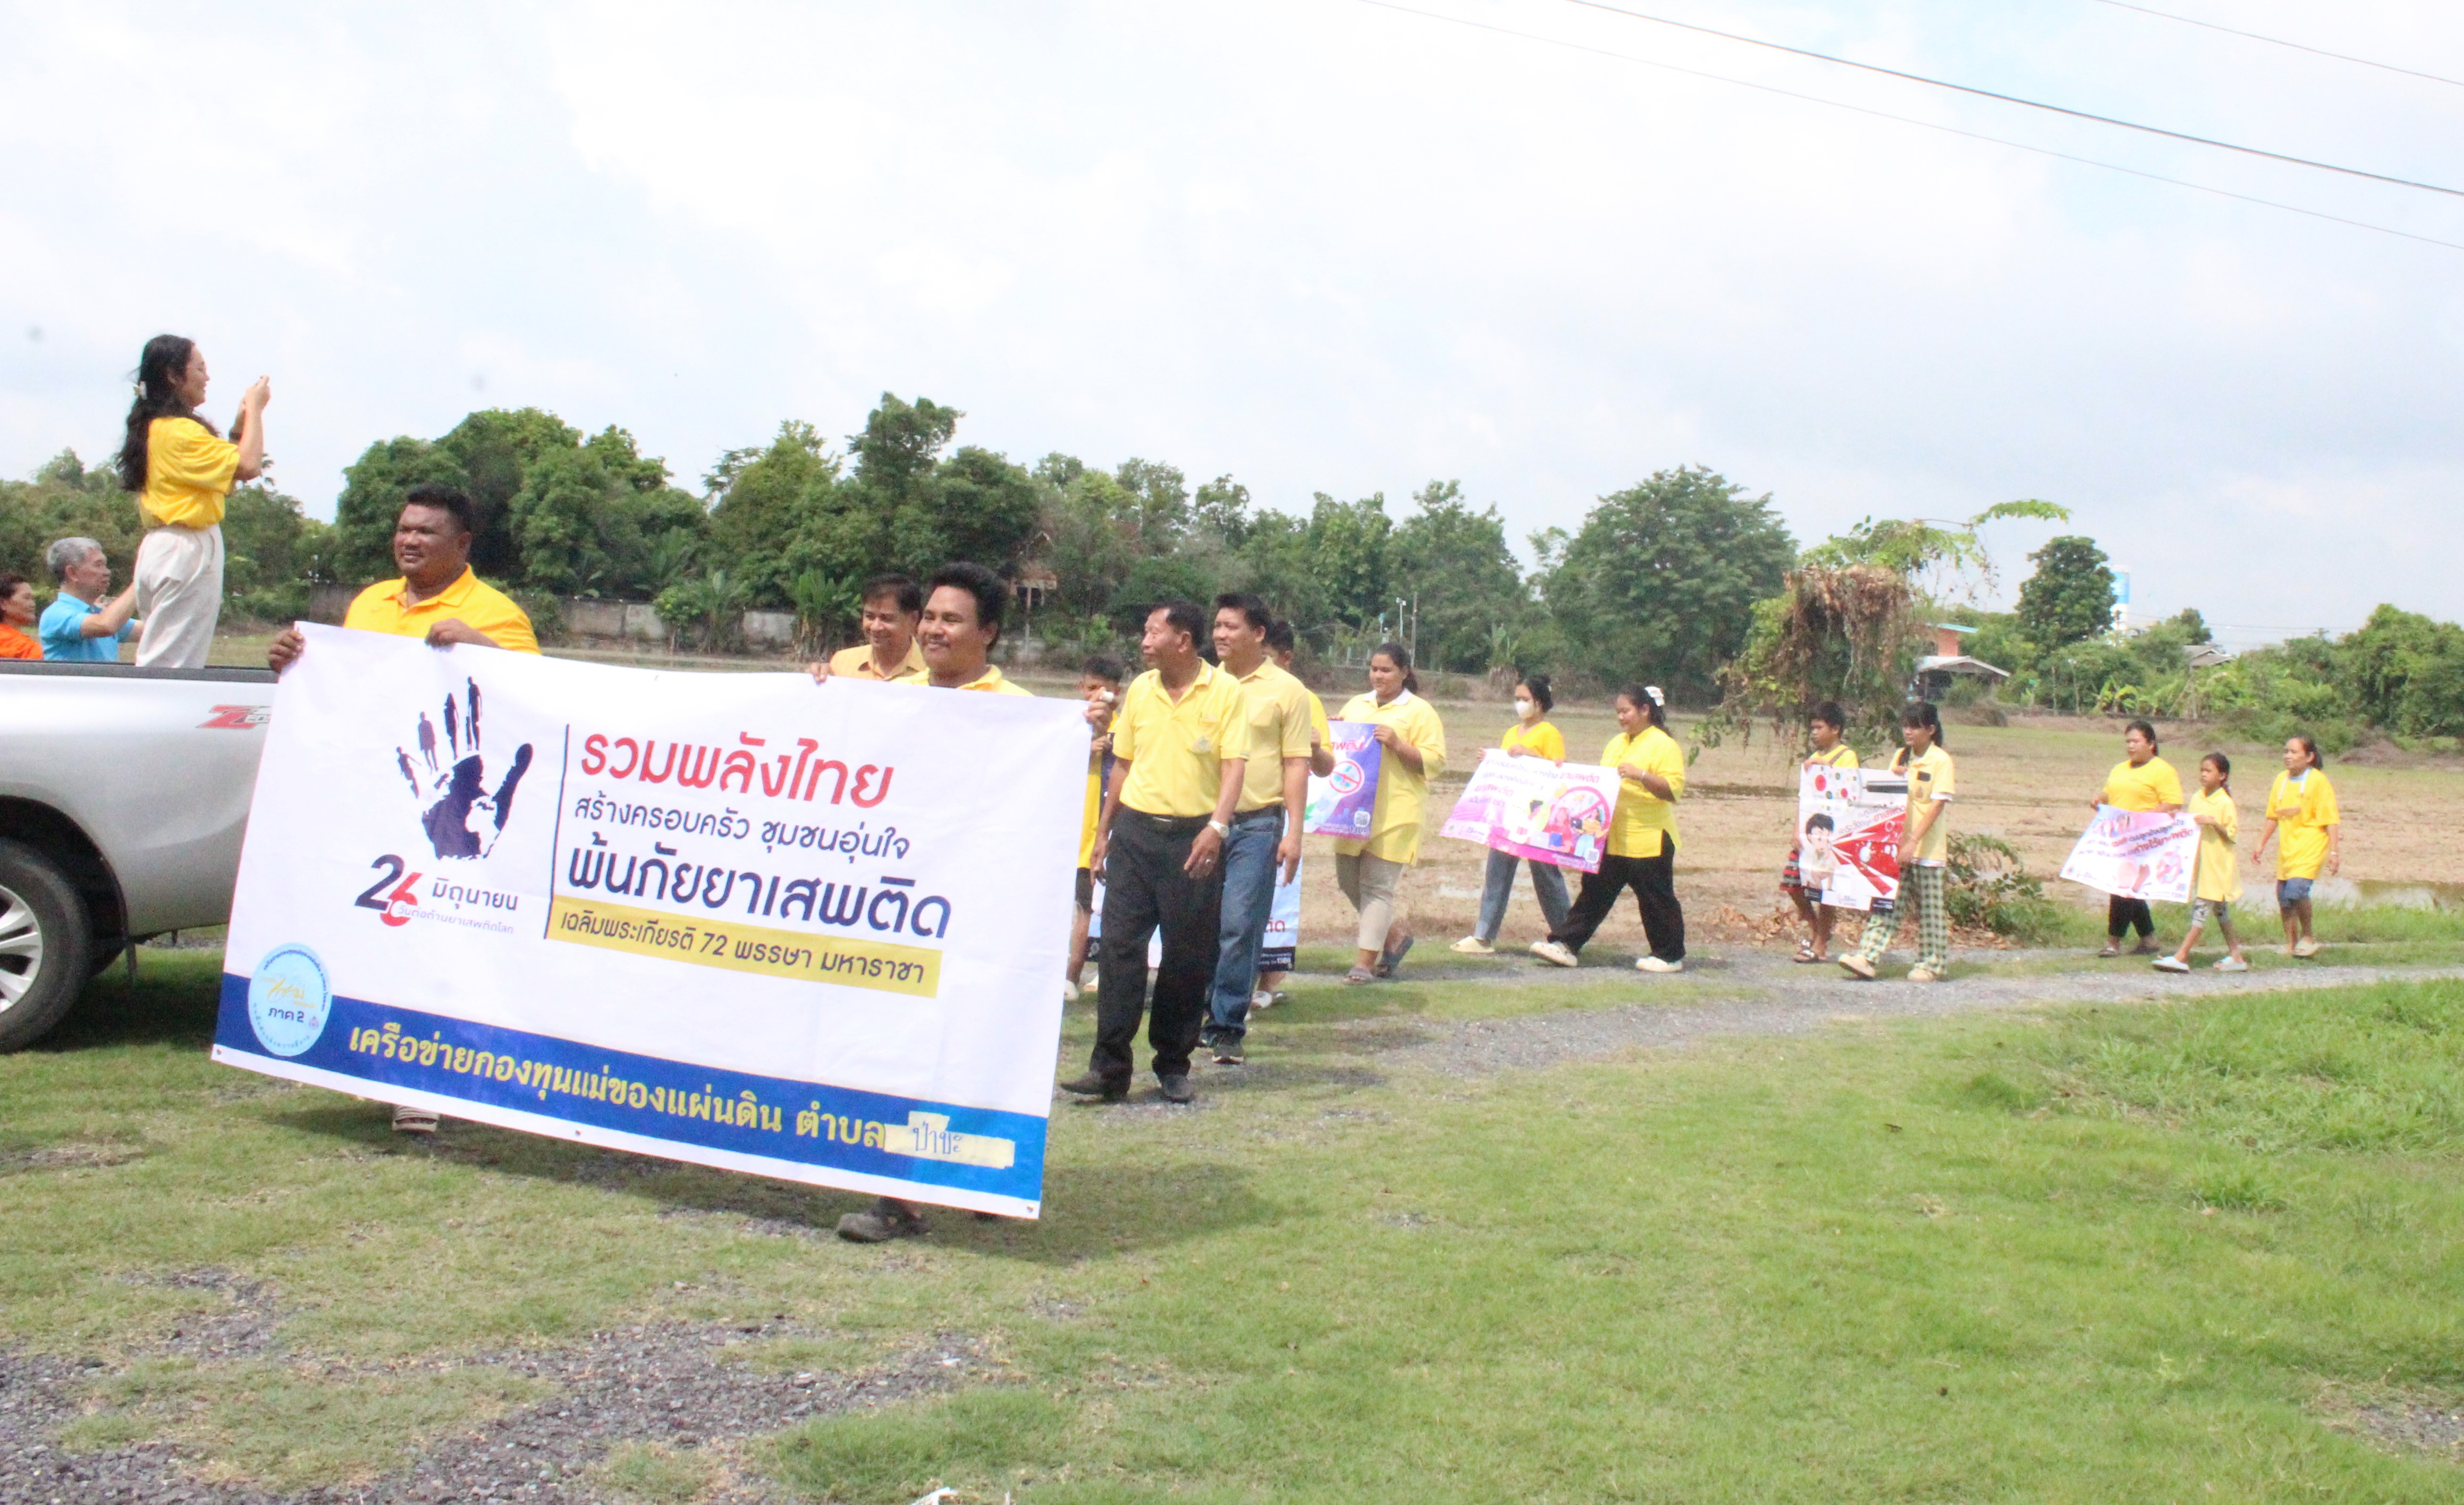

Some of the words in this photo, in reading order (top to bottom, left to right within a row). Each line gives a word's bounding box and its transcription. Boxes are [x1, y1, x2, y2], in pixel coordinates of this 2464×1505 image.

[581, 731, 895, 809] รวมพลังไทย
[575, 790, 751, 840] สร้างครอบครัว
[761, 821, 911, 864] ชุมชนอุ่นใจ
[354, 853, 424, 927] 26
[431, 877, 519, 910] มิถุนายน
[397, 904, 514, 935] วันต่อต้านยาเสพติดโลก
[568, 830, 952, 938] พ้นภัยยาเสพติด
[560, 909, 696, 951] เฉลิมพระเกียรติ
[699, 932, 729, 957] 72
[734, 939, 812, 969] พรรษา
[820, 951, 924, 984] มหาราชา
[268, 1008, 294, 1021] ภาค
[297, 1011, 306, 1024] 2
[348, 1021, 782, 1133] เครือข่ายกองทุนแม่ของแผ่นดิน
[796, 1101, 887, 1149] ตำบล
